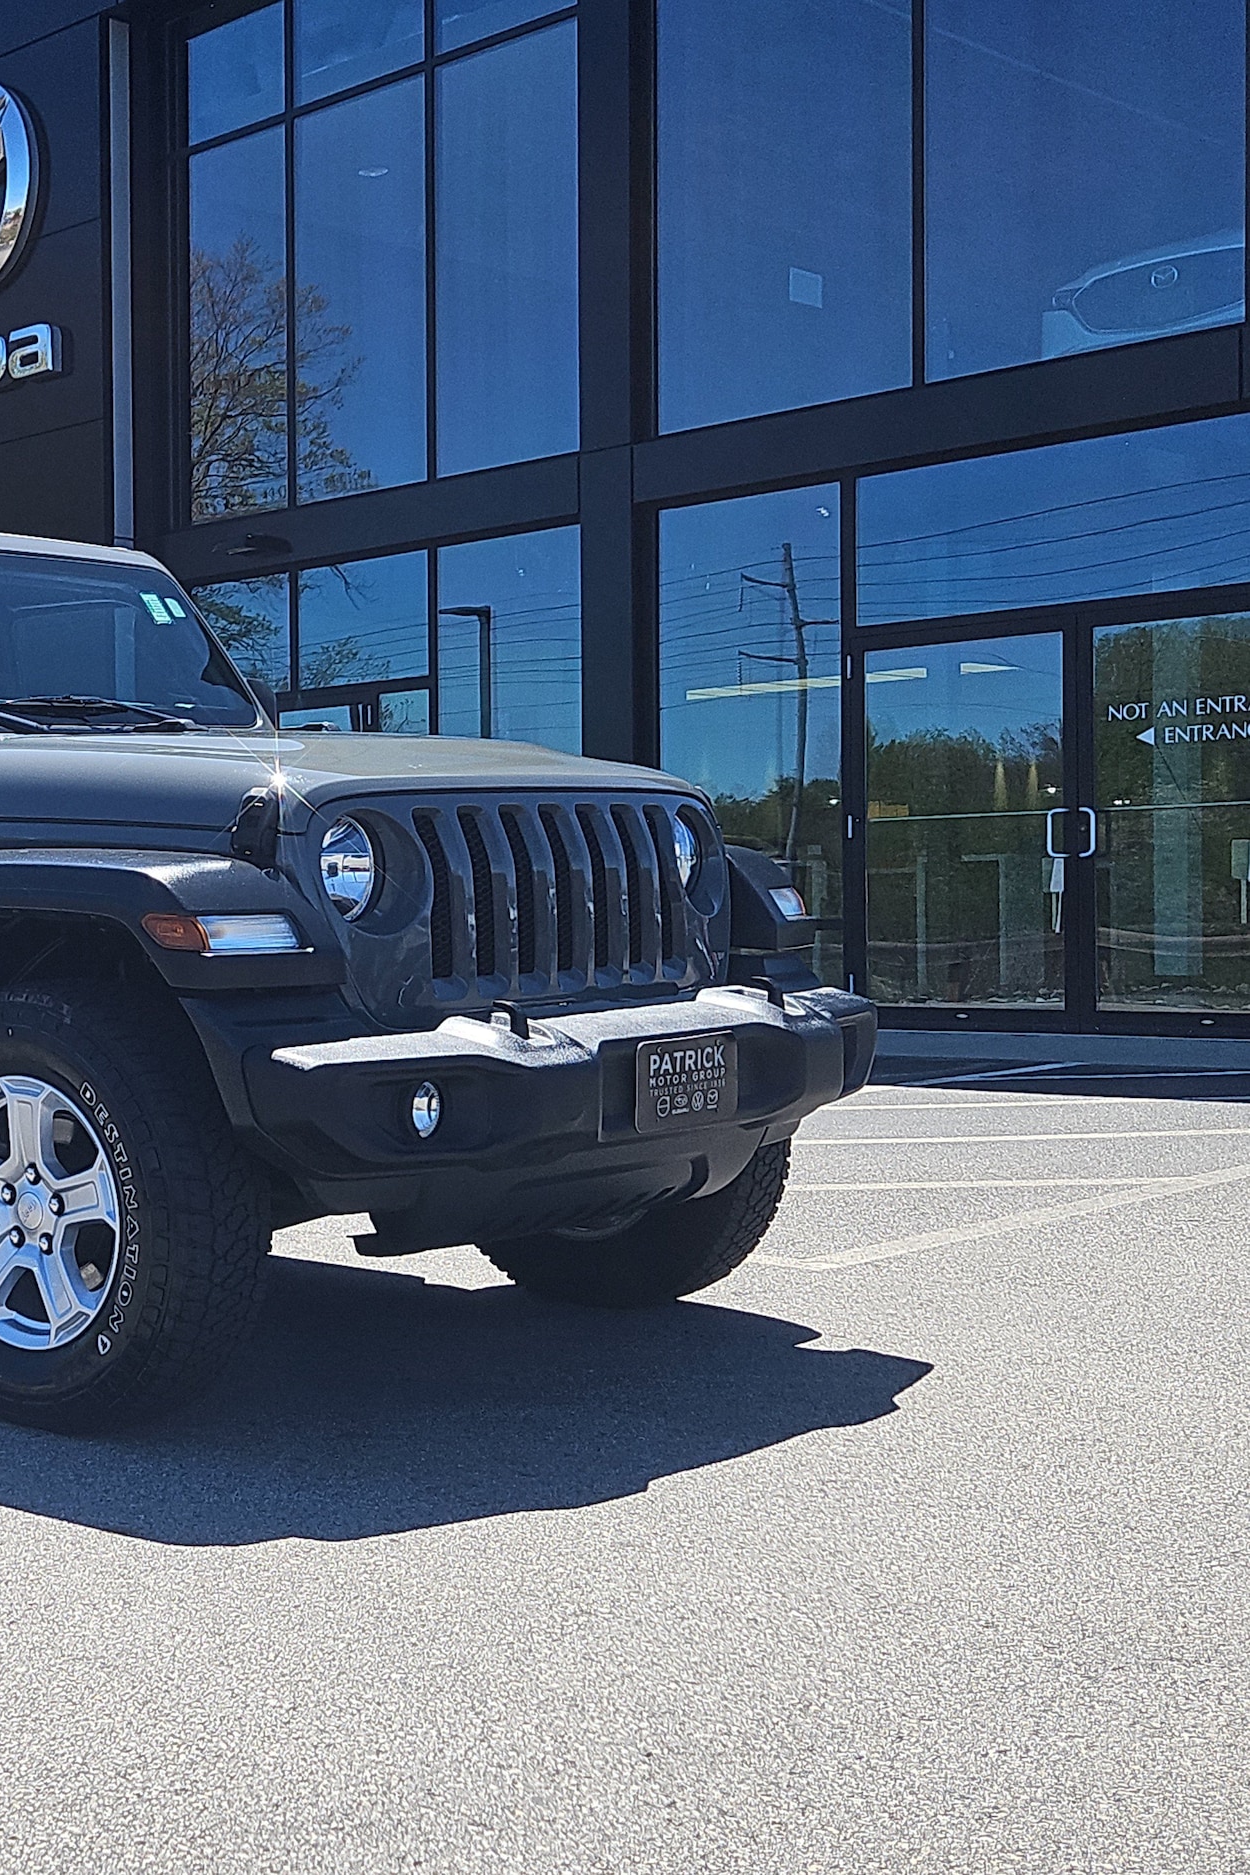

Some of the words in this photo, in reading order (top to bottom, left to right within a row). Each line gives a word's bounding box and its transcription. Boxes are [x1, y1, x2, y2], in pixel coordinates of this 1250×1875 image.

[1108, 702, 1149, 721] NOT
[1157, 699, 1188, 718] AN
[1195, 695, 1250, 715] ENTR
[649, 1045, 726, 1077] PATRICK
[649, 1073, 687, 1088] MOTOR
[692, 1067, 726, 1082] GROUP
[650, 1086, 683, 1097] TRUSTED
[686, 1081, 708, 1092] SINCE
[80, 1081, 140, 1334] DESTINATION
